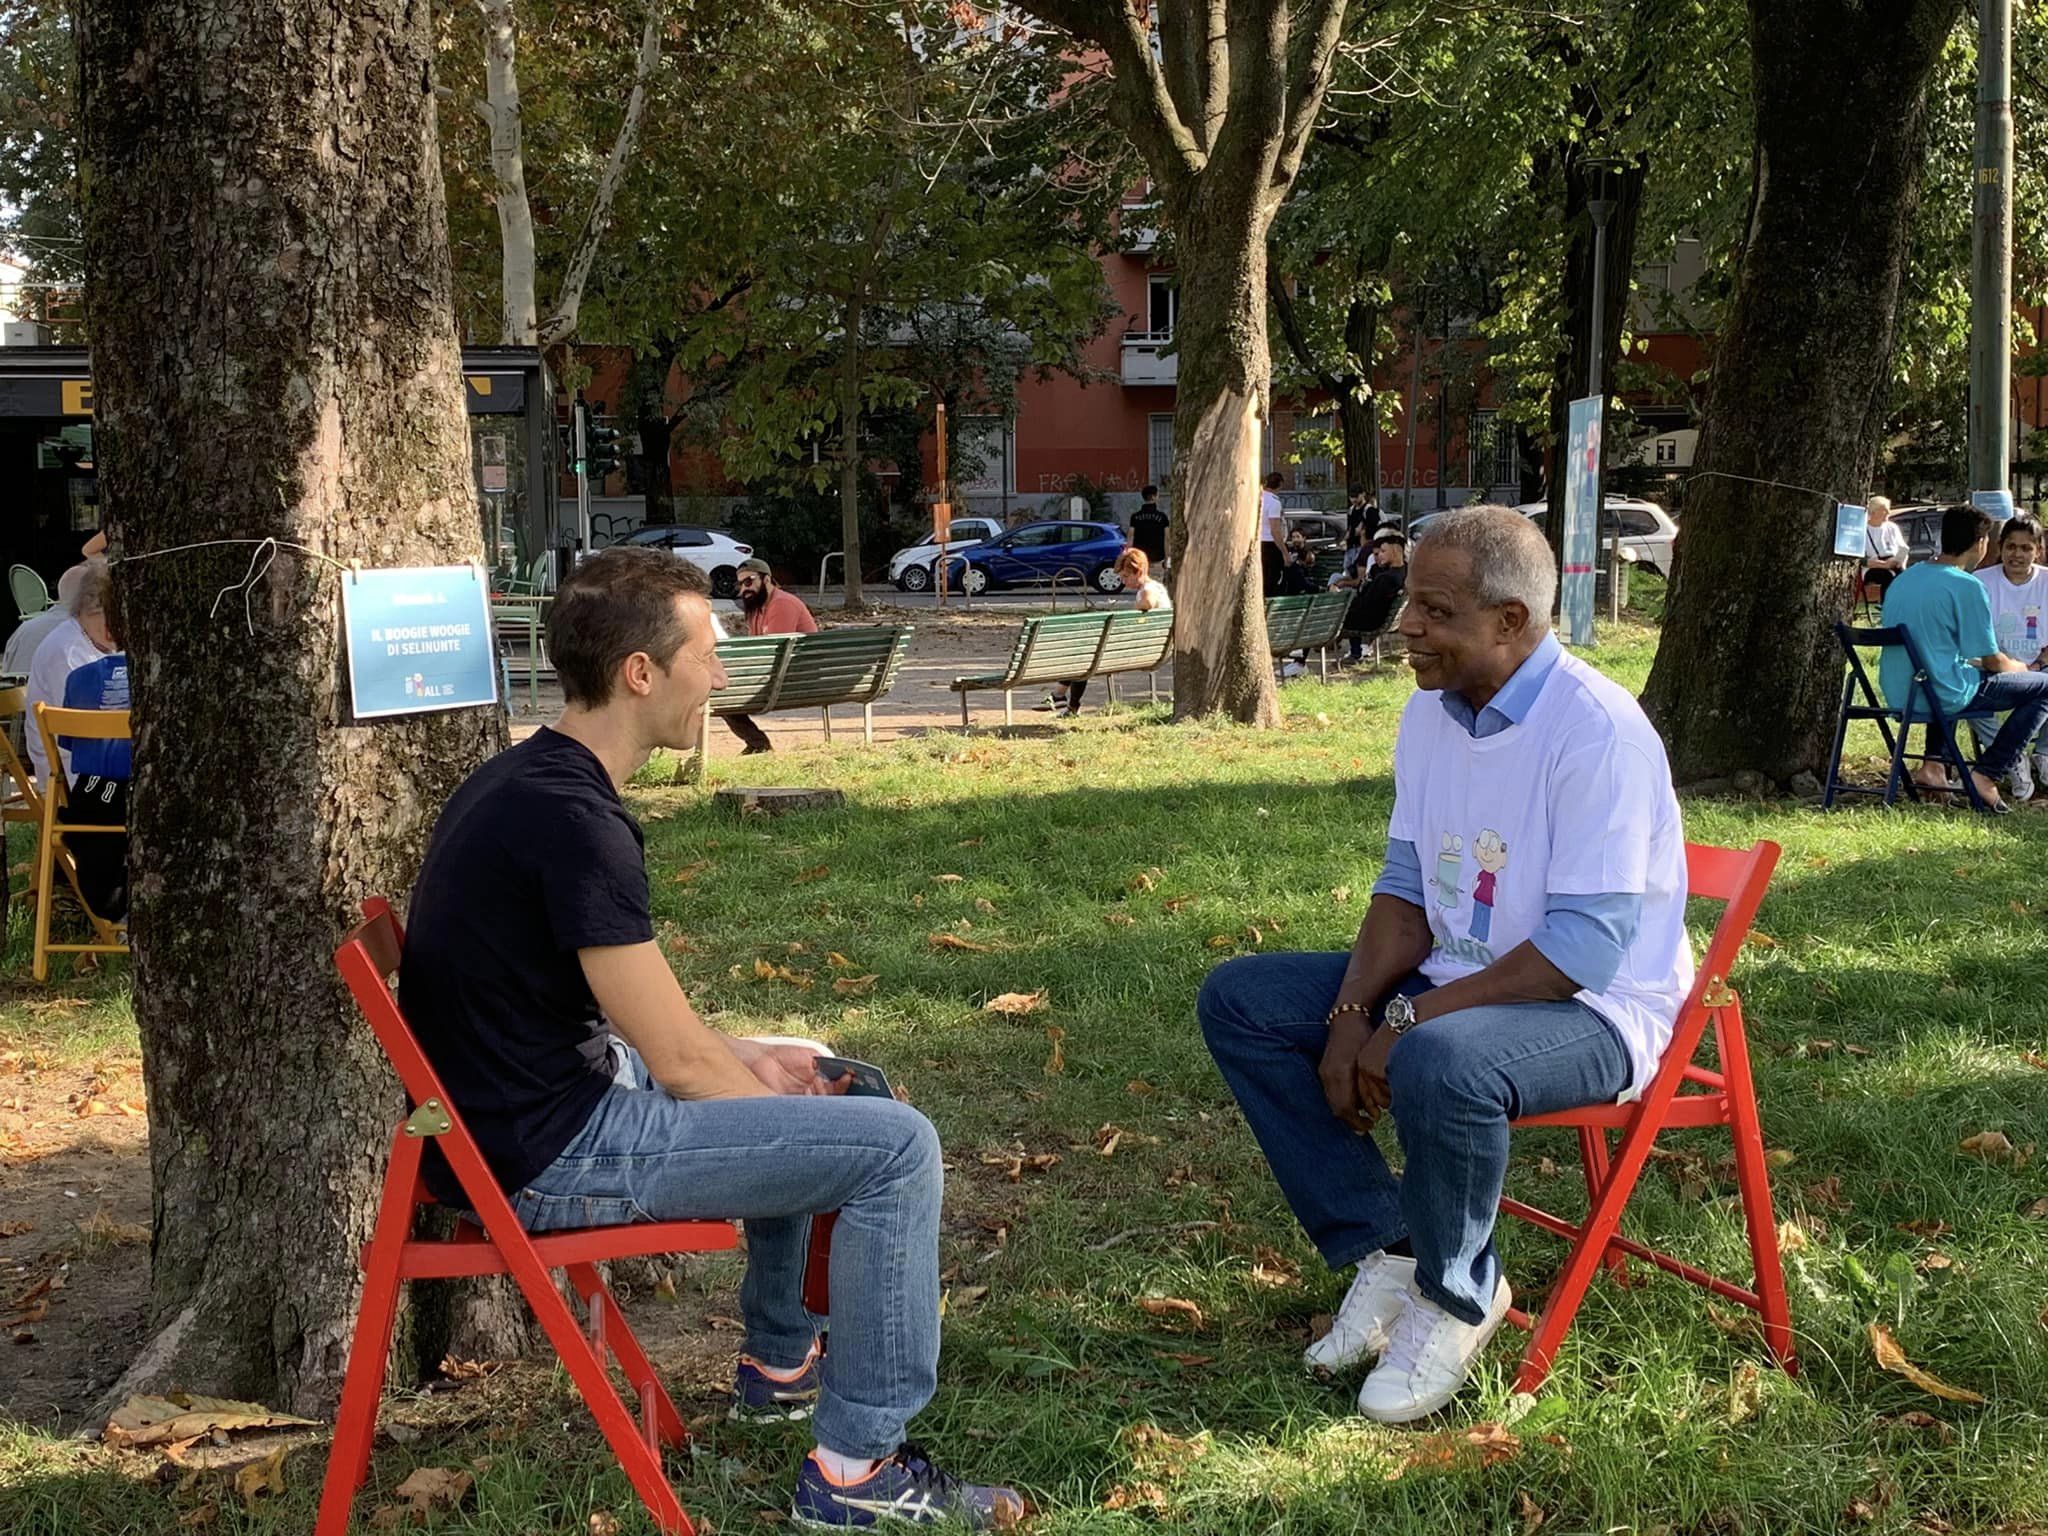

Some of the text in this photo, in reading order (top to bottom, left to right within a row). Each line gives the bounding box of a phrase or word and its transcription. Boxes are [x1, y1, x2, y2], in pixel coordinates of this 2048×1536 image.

[1978, 167, 2000, 185] 1612
[371, 624, 471, 642] IL BOOGIE WOOGIE
[387, 639, 461, 656] DI SELINUNTE
[424, 685, 441, 697] ALL
